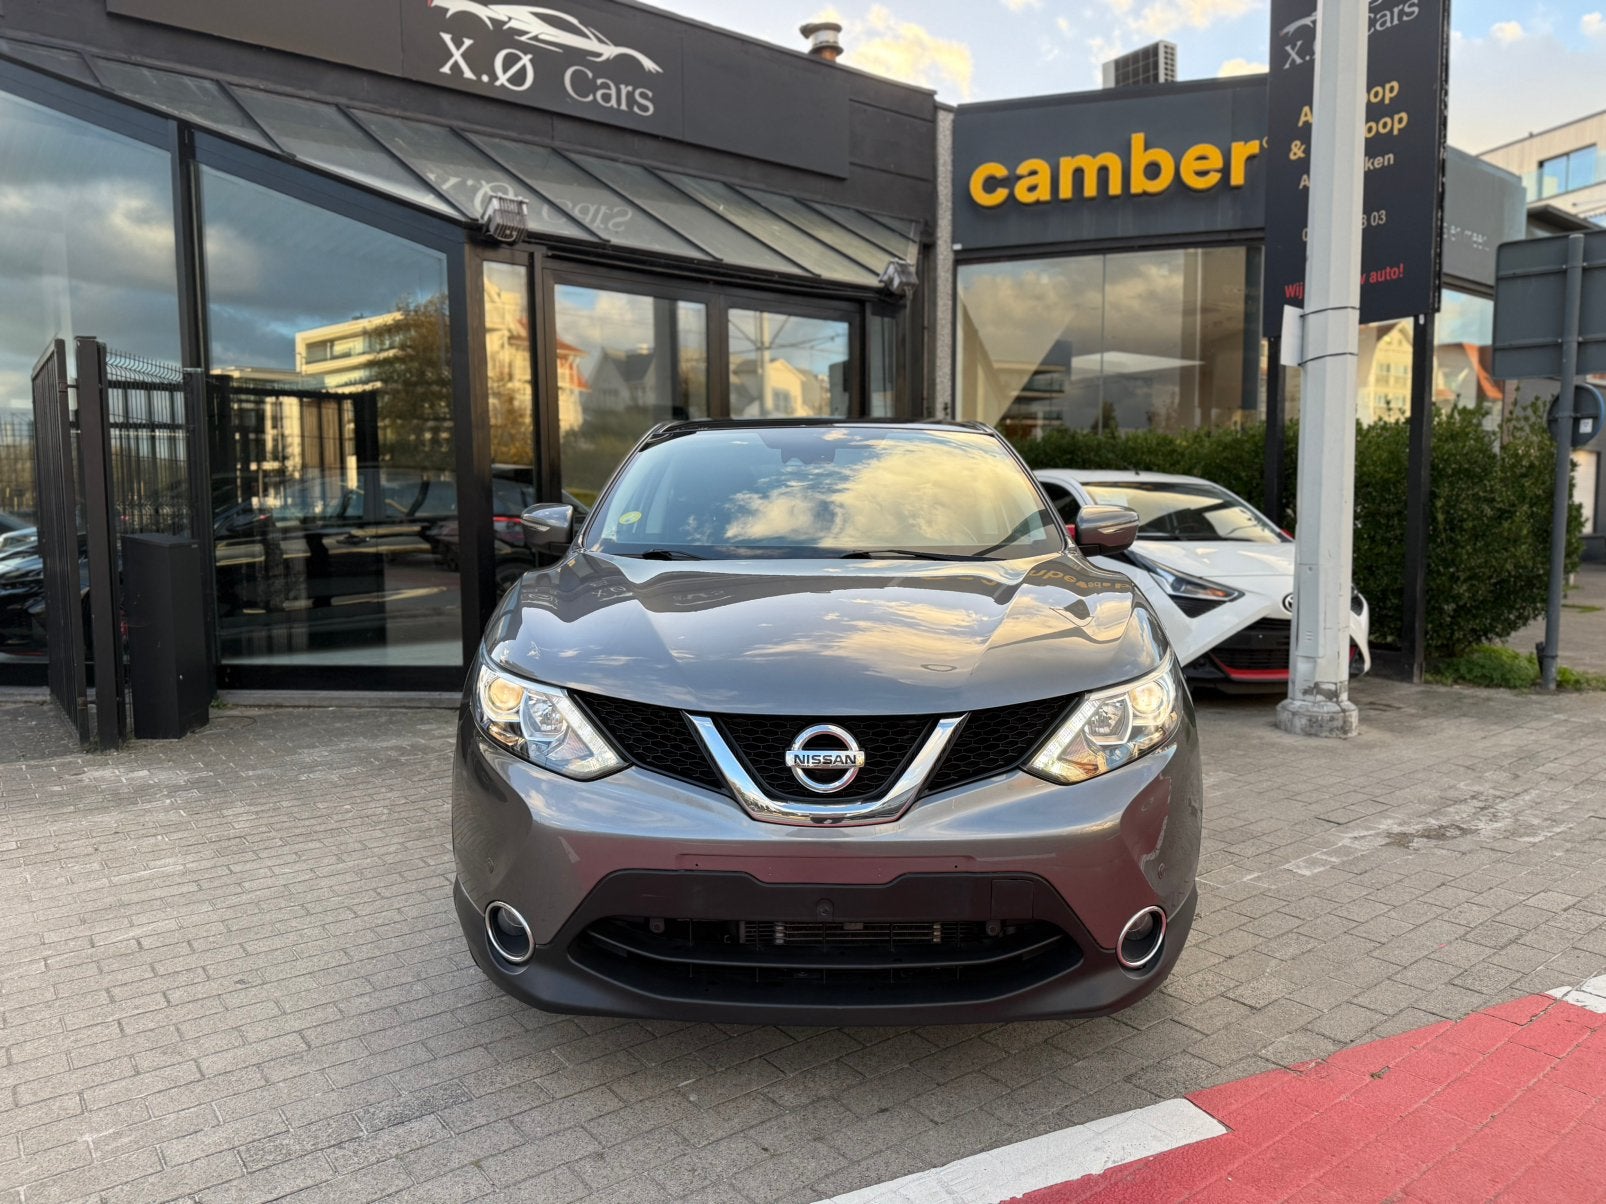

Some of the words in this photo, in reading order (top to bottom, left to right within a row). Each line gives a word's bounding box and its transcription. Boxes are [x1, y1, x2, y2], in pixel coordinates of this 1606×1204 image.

[1283, 40, 1317, 70] X.
[563, 65, 655, 117] Cars
[1289, 140, 1306, 160] &
[969, 132, 1260, 207] camber
[1370, 209, 1386, 226] 03
[1285, 282, 1304, 299] Wij
[1369, 263, 1404, 284] auto!
[793, 754, 857, 765] NISSAN
